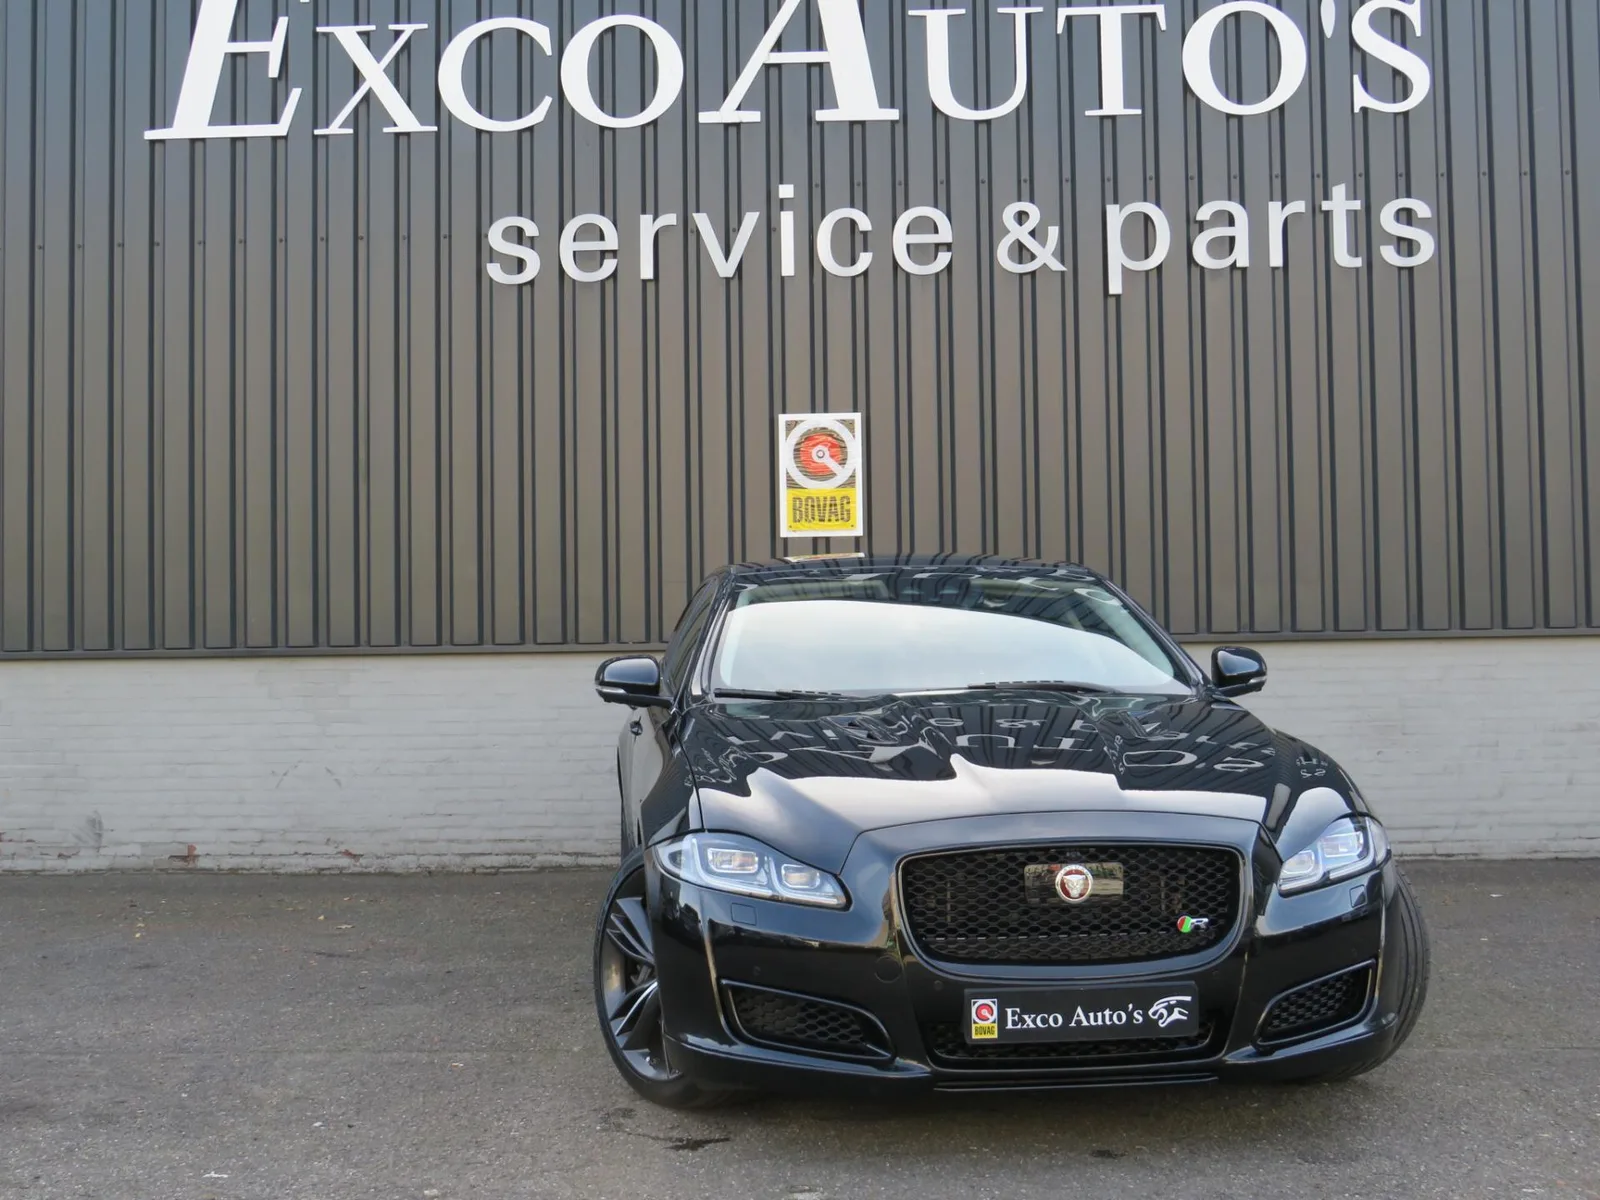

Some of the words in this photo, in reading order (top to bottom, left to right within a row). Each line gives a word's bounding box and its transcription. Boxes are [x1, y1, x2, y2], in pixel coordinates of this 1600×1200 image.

[486, 184, 953, 285] service
[996, 201, 1066, 274] &
[1105, 183, 1436, 296] parts
[792, 495, 851, 523] BOVAG
[1005, 1007, 1063, 1029] Exco
[1069, 1003, 1143, 1027] Auto's
[974, 1025, 996, 1036] BOVAG
